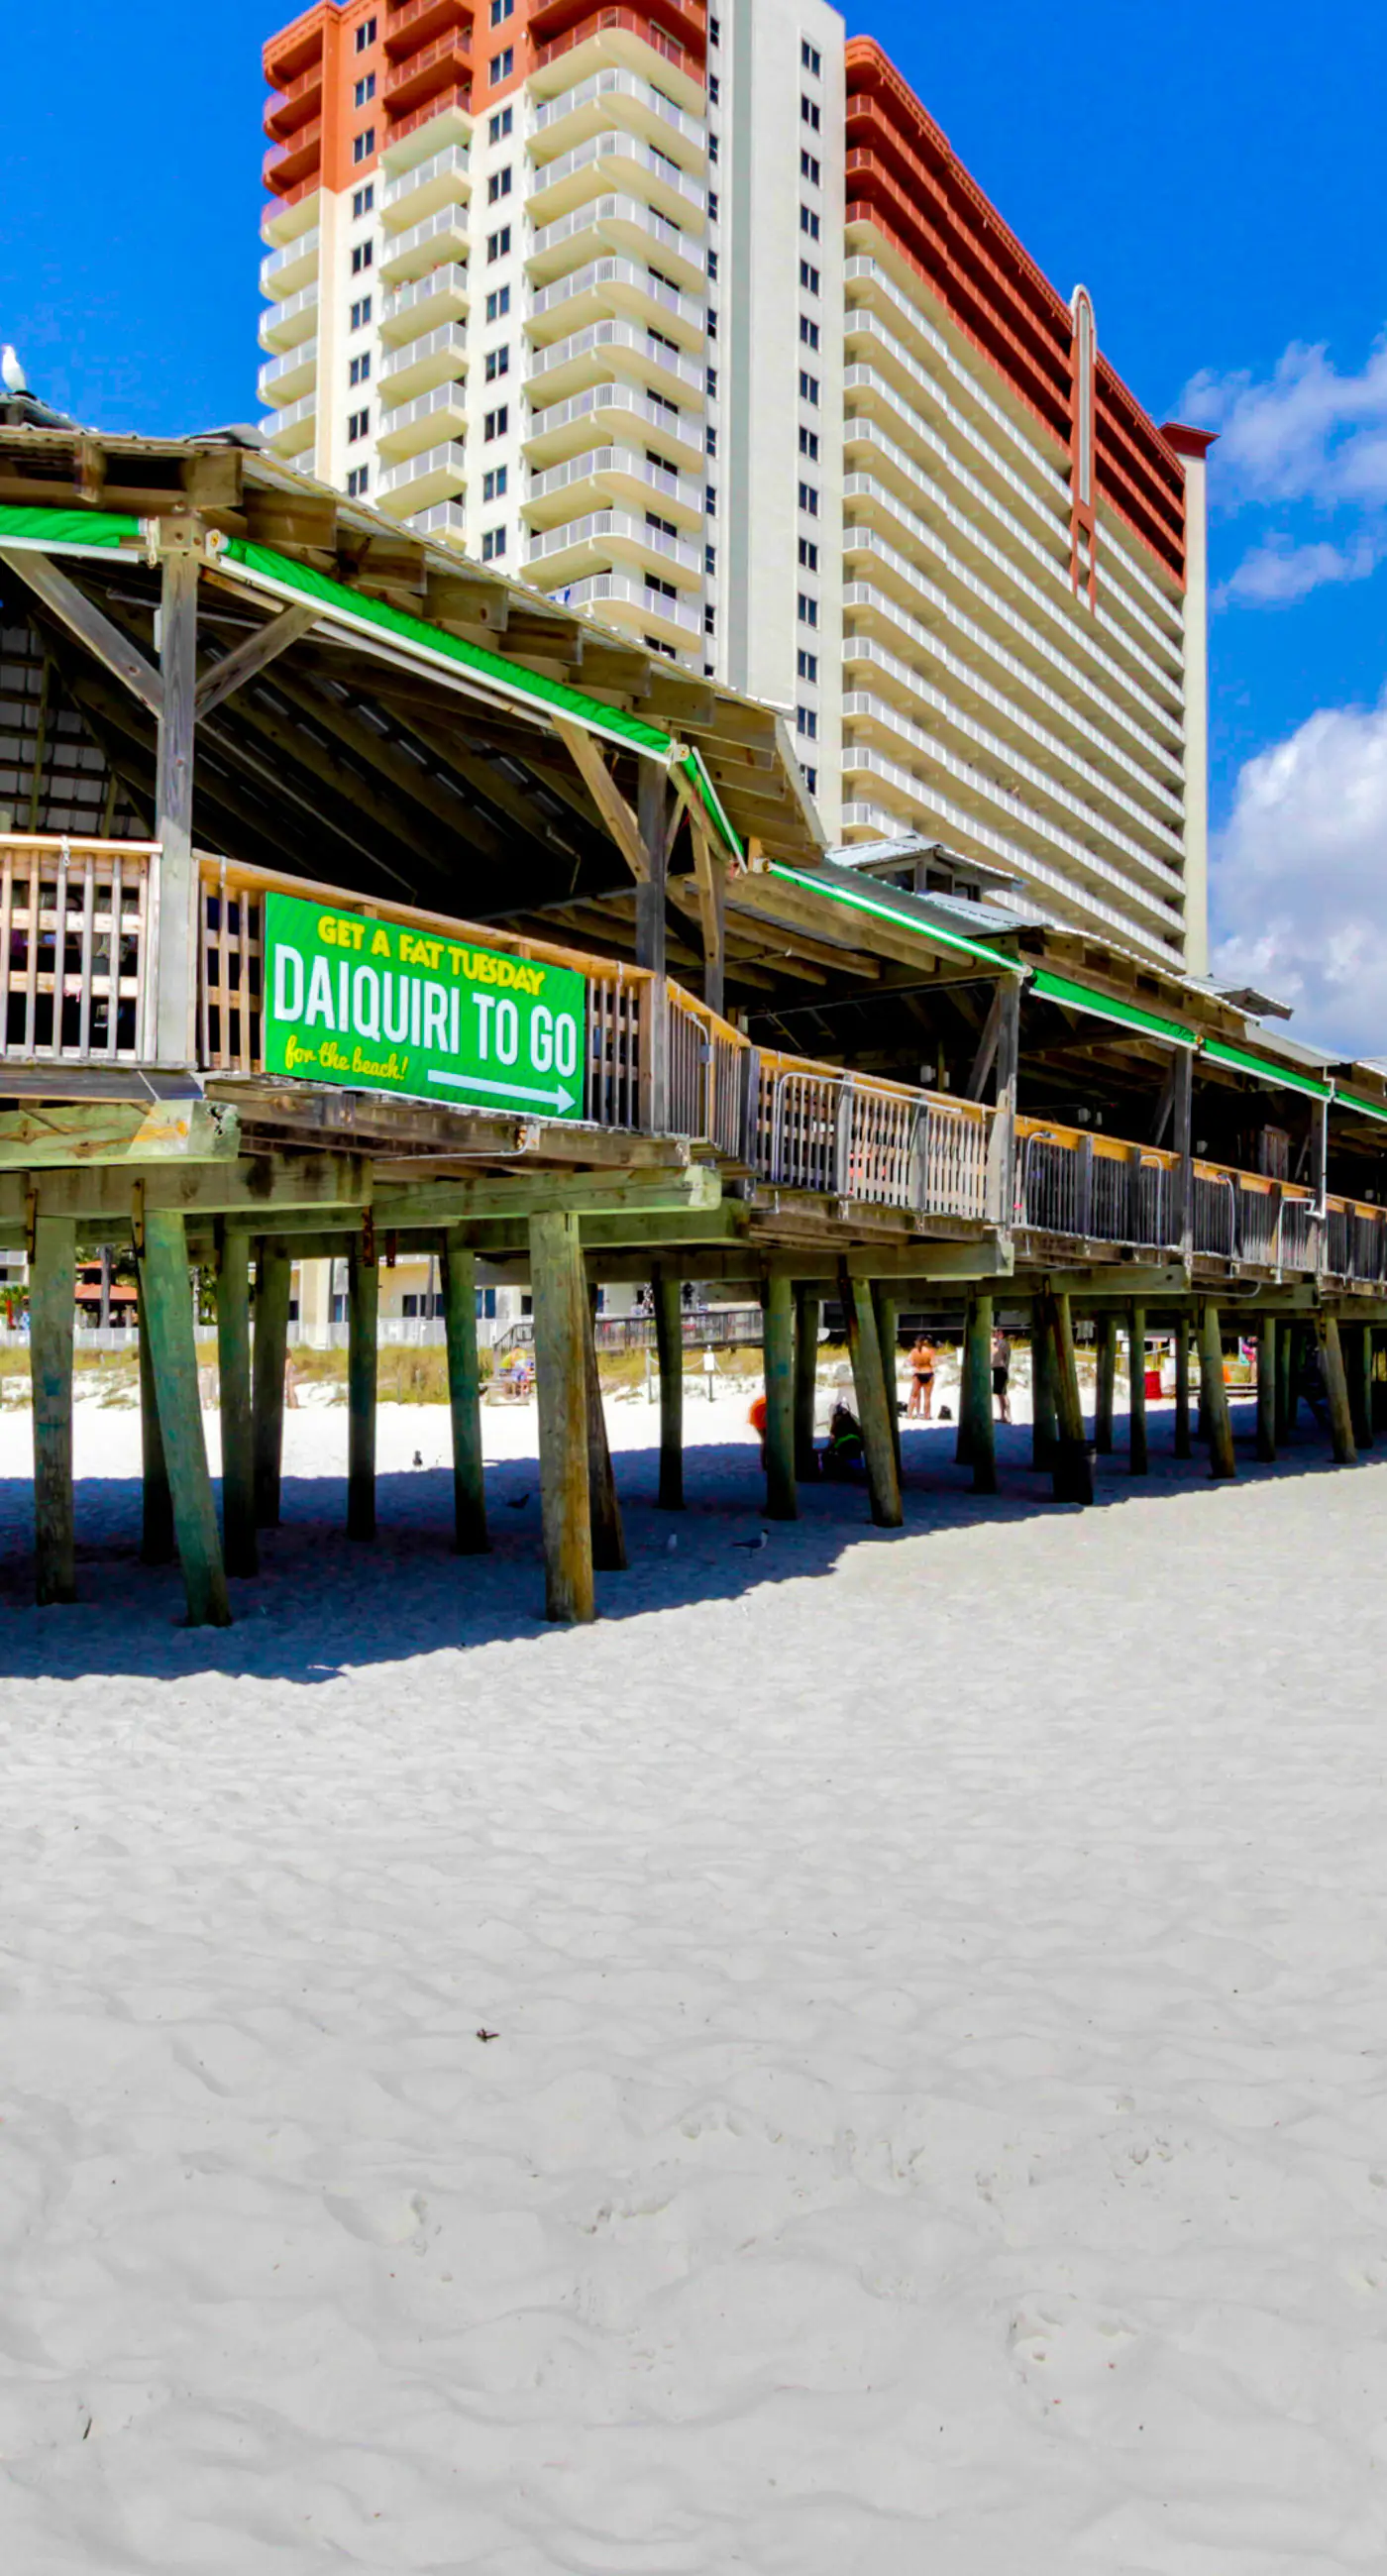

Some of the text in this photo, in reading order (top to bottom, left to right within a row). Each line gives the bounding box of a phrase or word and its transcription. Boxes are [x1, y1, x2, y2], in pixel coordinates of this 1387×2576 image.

[317, 915, 545, 996] GET A FAT TUESDAY
[274, 943, 577, 1077] DAIQUIRI TO GO
[284, 1034, 408, 1080] for the beach!
